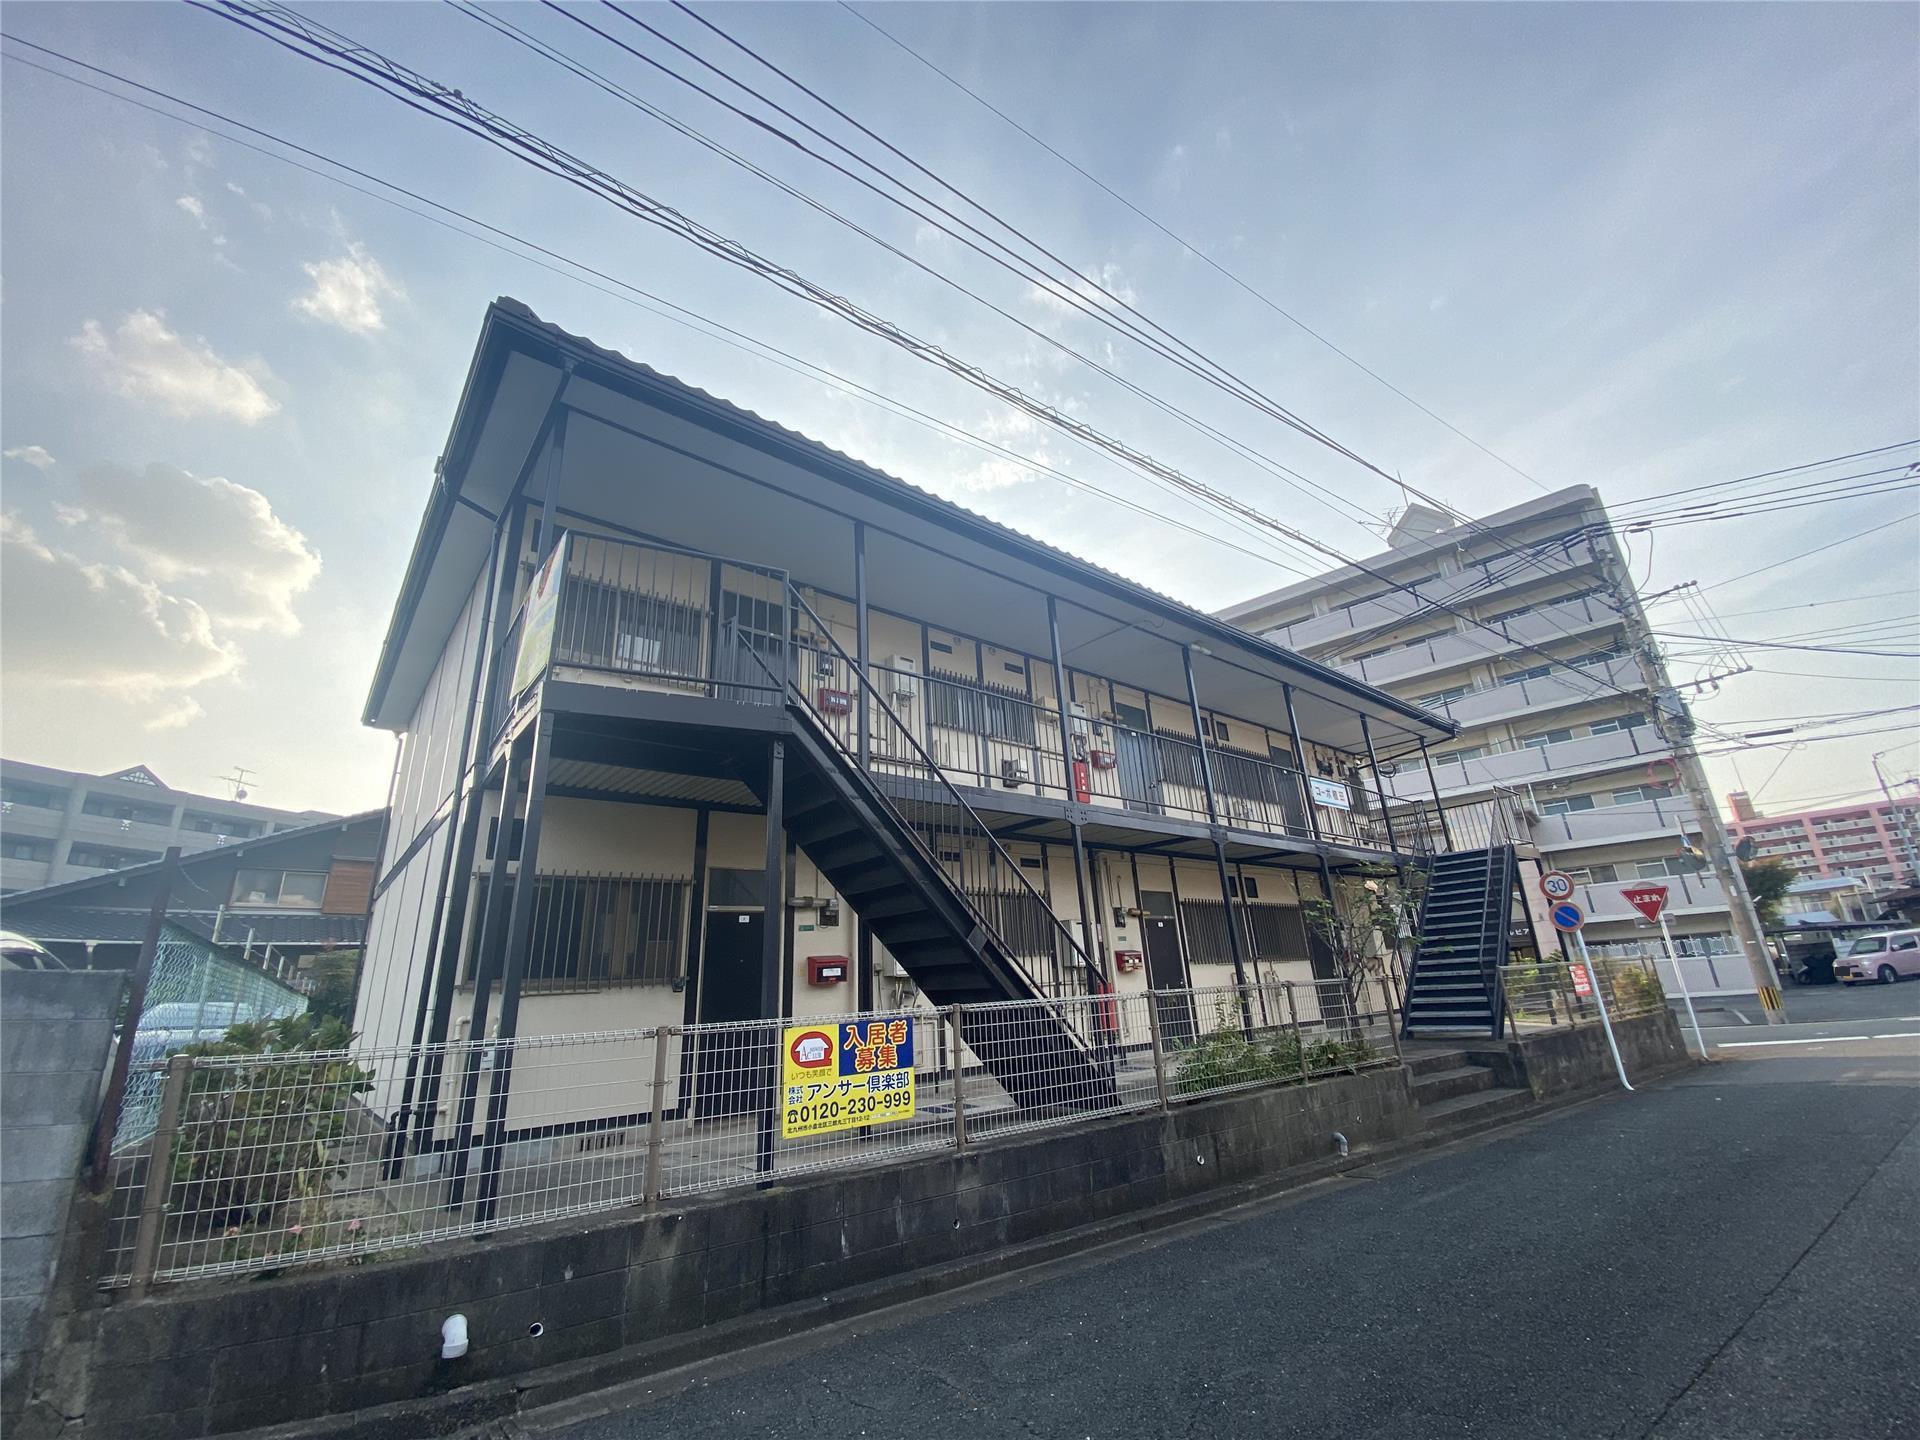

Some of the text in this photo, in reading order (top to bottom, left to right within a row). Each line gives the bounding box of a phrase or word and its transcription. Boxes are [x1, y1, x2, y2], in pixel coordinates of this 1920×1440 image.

[1547, 878, 1567, 893] 30
[1633, 893, 1661, 905] 止まれ
[844, 1021, 907, 1050] 入居者
[855, 1045, 897, 1073] 募集
[791, 1068, 832, 1080] いつも笑顔で
[807, 1072, 910, 1101] アンサー倶楽部
[800, 1091, 911, 1123] 0120-230-999
